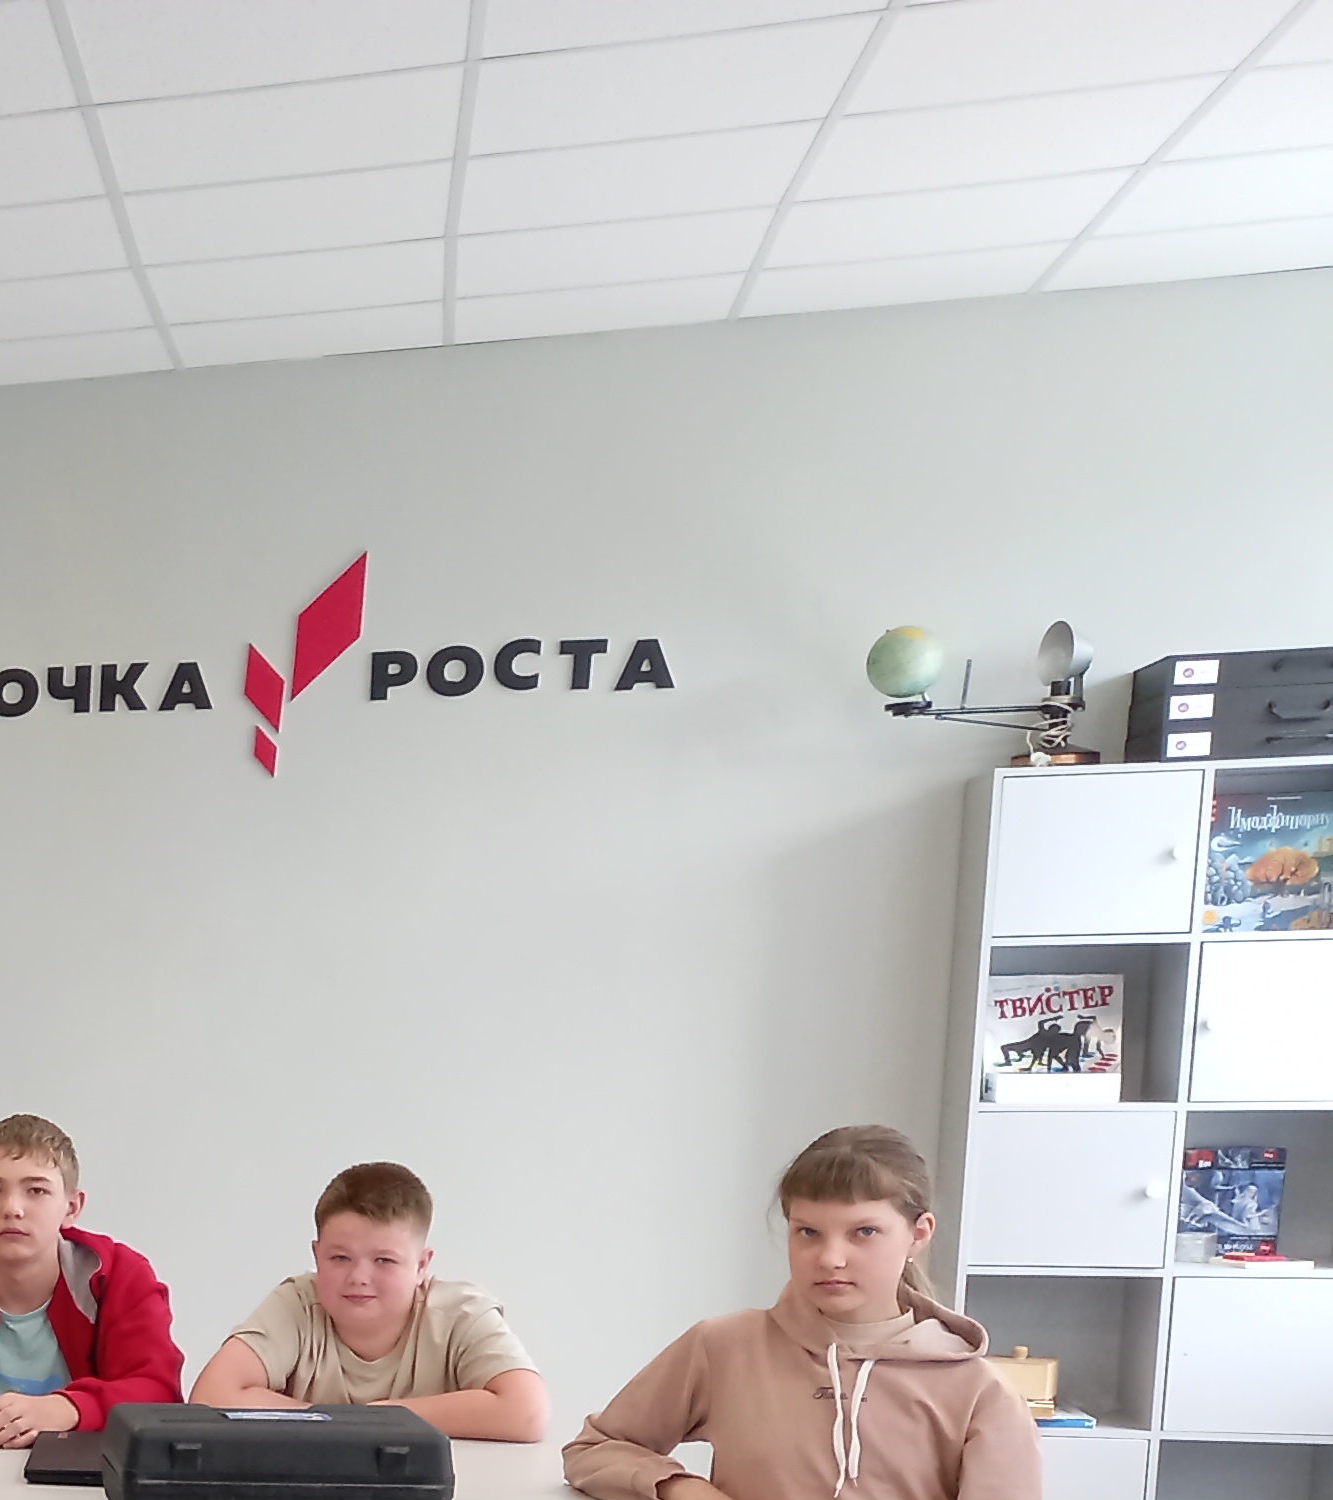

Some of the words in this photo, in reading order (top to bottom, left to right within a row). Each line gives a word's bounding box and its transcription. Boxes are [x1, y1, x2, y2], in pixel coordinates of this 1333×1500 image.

[369, 637, 678, 702] РОСТА
[1227, 804, 1330, 833] Имаджинариу
[994, 984, 1115, 1020] ТВИСТЕР
